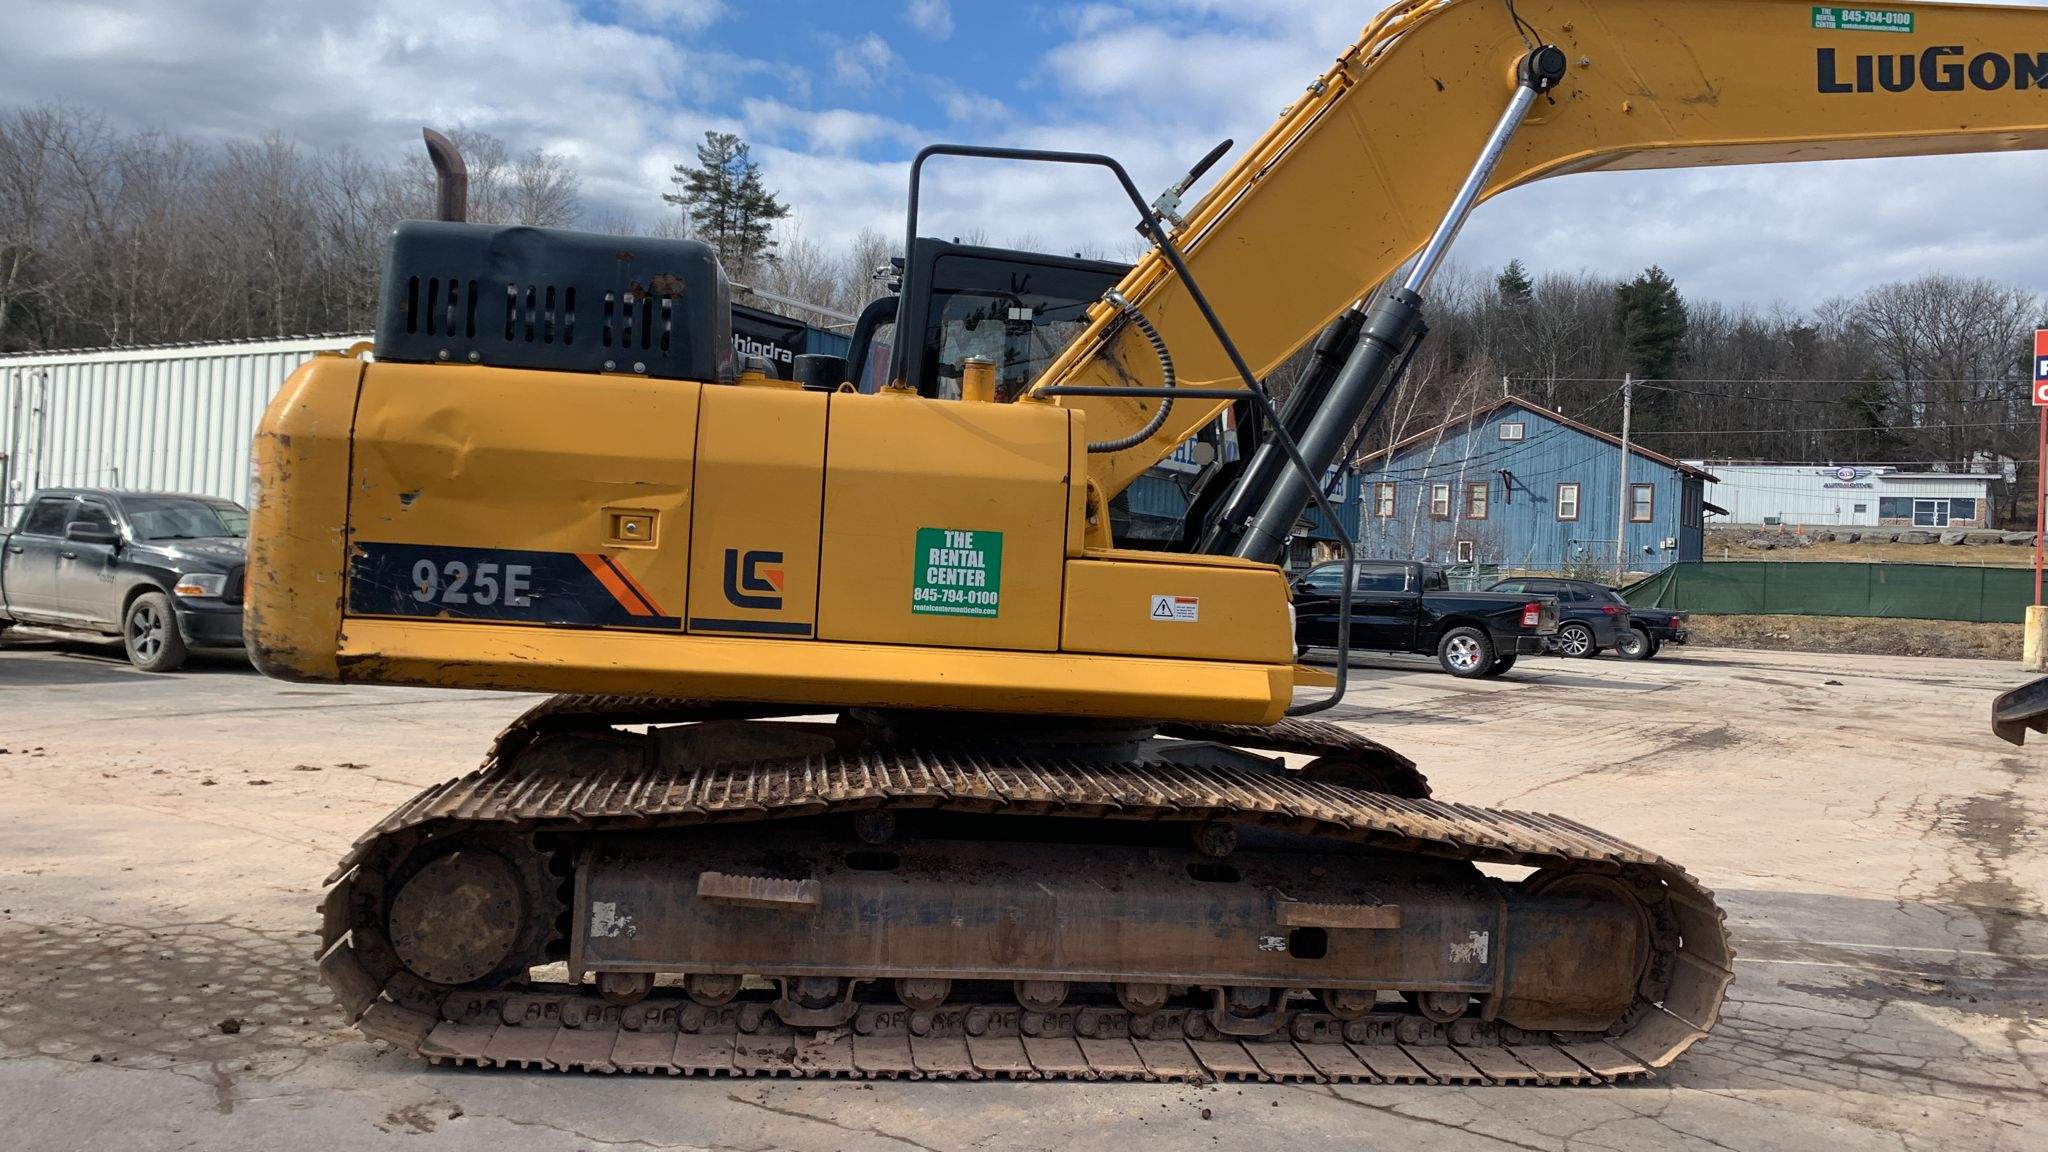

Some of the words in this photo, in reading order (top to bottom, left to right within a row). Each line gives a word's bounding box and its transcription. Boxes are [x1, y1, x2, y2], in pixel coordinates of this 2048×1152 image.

[1815, 21, 1836, 29] CENTER
[1842, 10, 1910, 25] 845-794-0100
[731, 333, 793, 364] hindra
[944, 530, 974, 549] THE
[928, 548, 986, 568] RENTAL
[411, 558, 532, 607] 925E
[926, 567, 986, 587] CENTER
[914, 587, 998, 605] 845-794-0100
[913, 604, 997, 615] rentalcentermonticello.com
